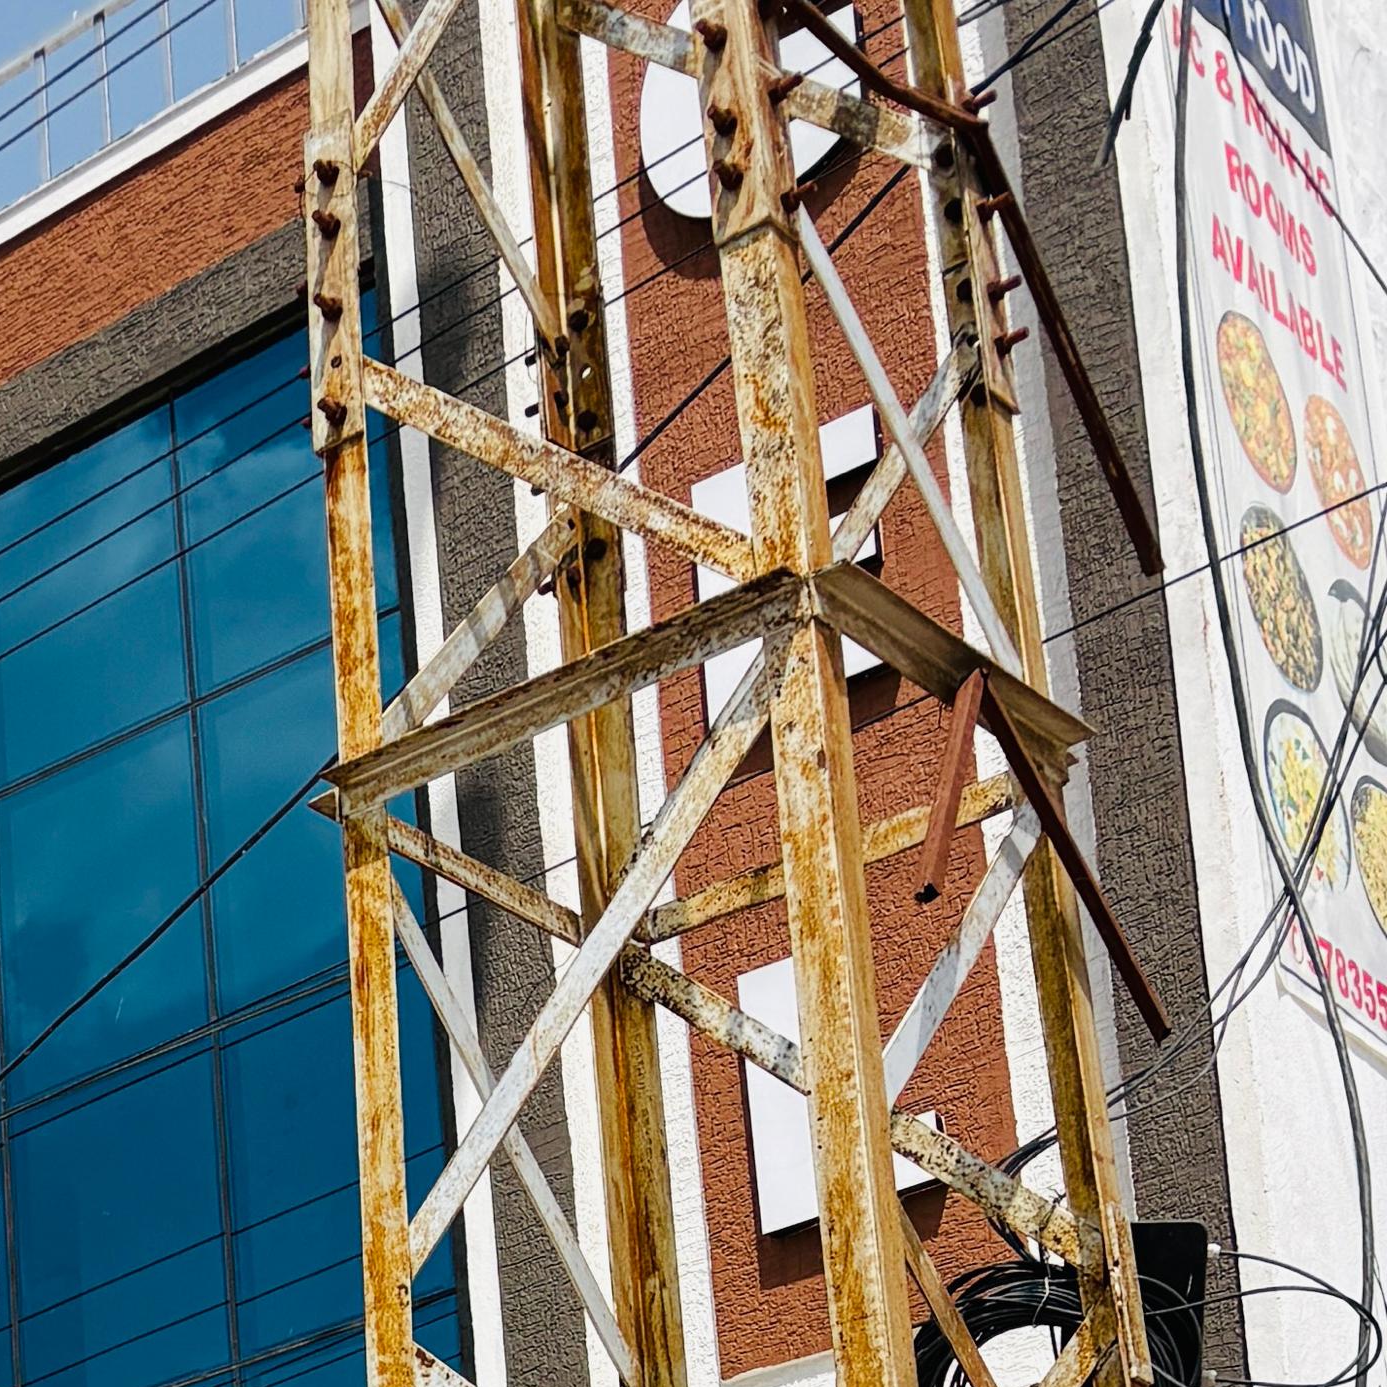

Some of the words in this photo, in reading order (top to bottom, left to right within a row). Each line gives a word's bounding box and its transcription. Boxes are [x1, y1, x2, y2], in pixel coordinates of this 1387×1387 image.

[1215, 50, 1236, 107] &
[1225, 140, 1317, 277] ROOMS
[1212, 212, 1348, 393] AVAILABLE
